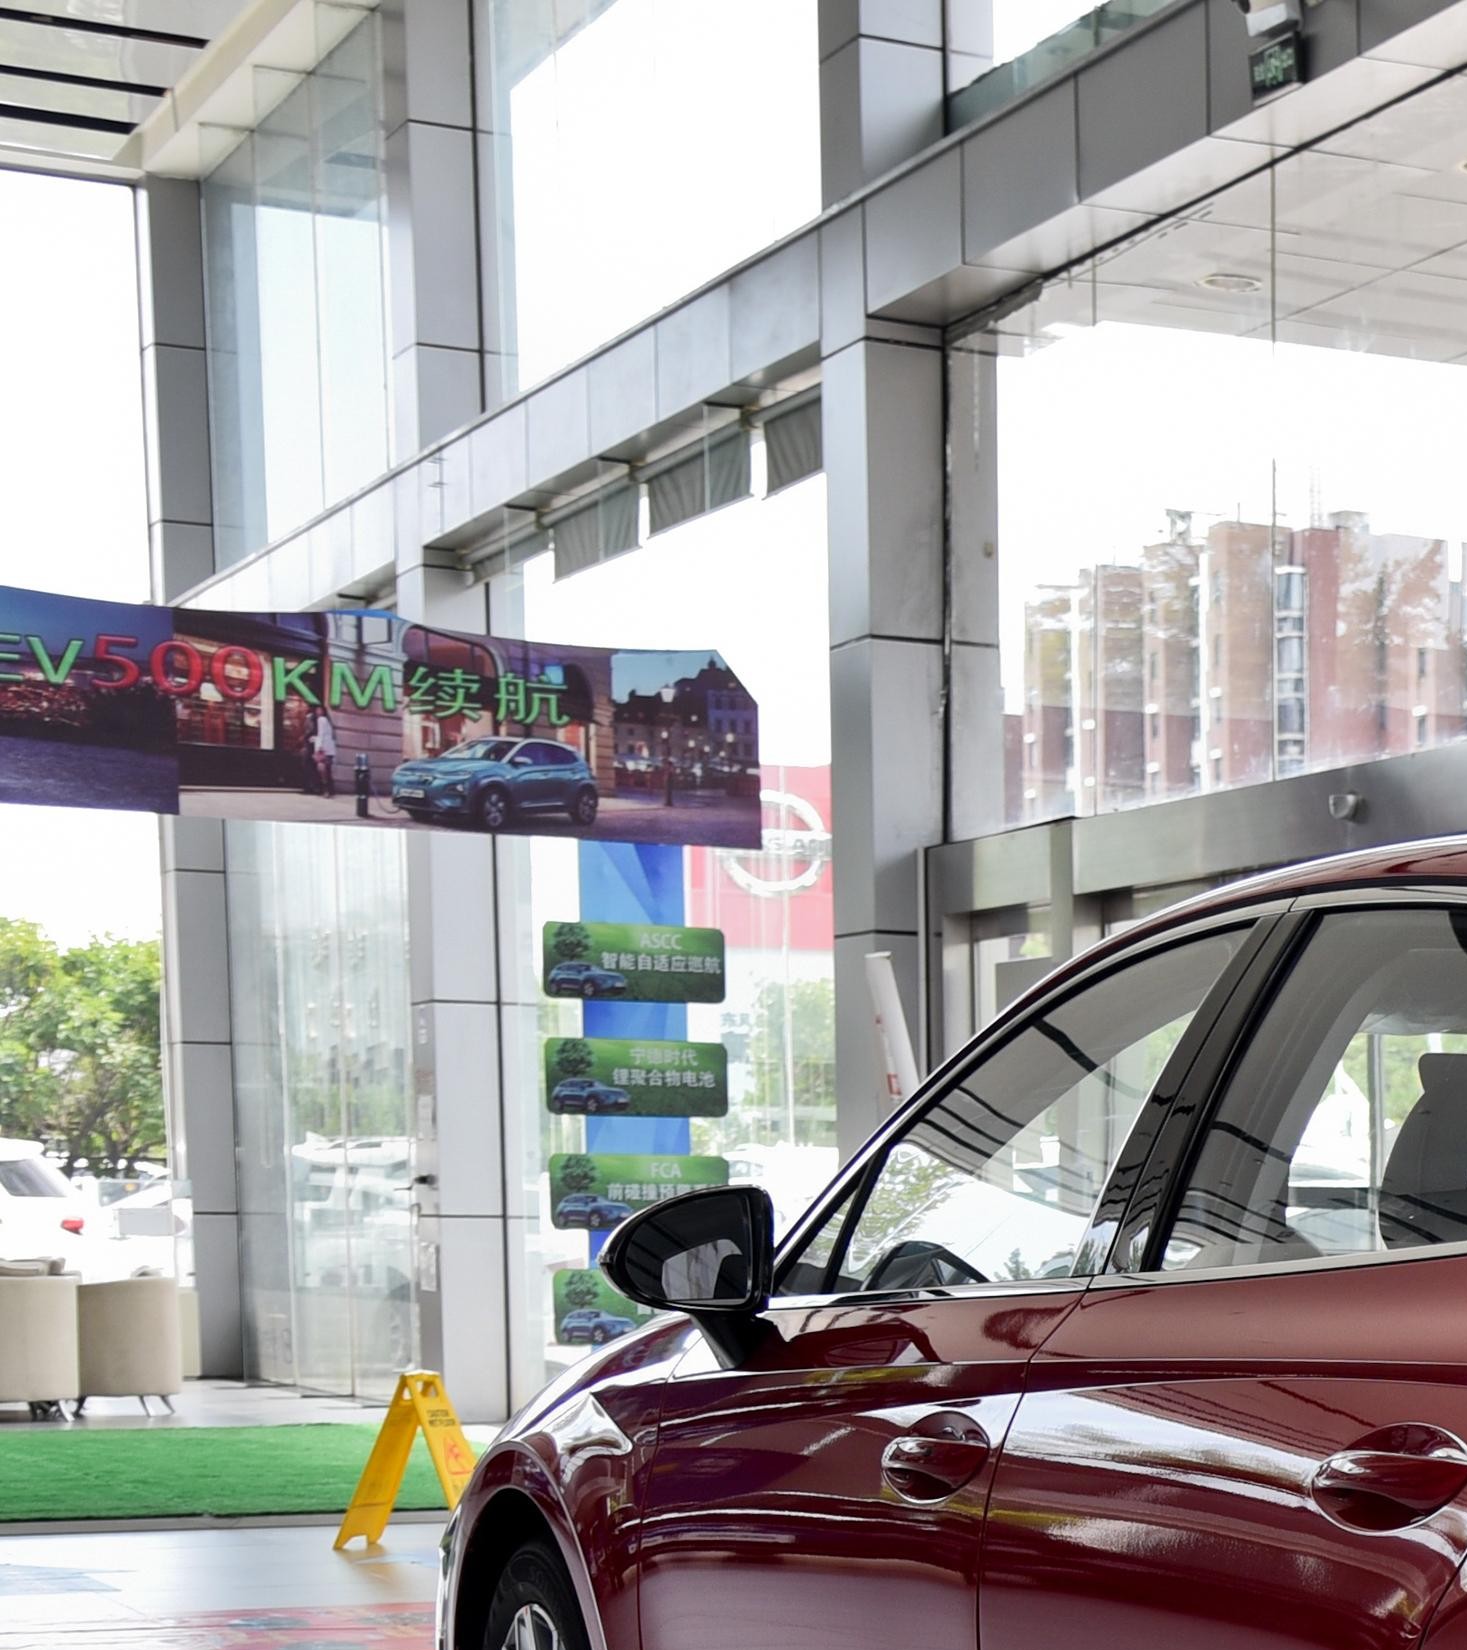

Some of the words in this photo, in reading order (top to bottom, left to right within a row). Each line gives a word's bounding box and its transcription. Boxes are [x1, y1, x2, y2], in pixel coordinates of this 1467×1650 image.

[639, 932, 683, 950] ASCC
[601, 951, 723, 974] 智能自适应巡航
[629, 1047, 699, 1067] 宁德时代
[612, 1068, 717, 1089] 锂聚合物电池
[650, 1162, 682, 1179] FCA
